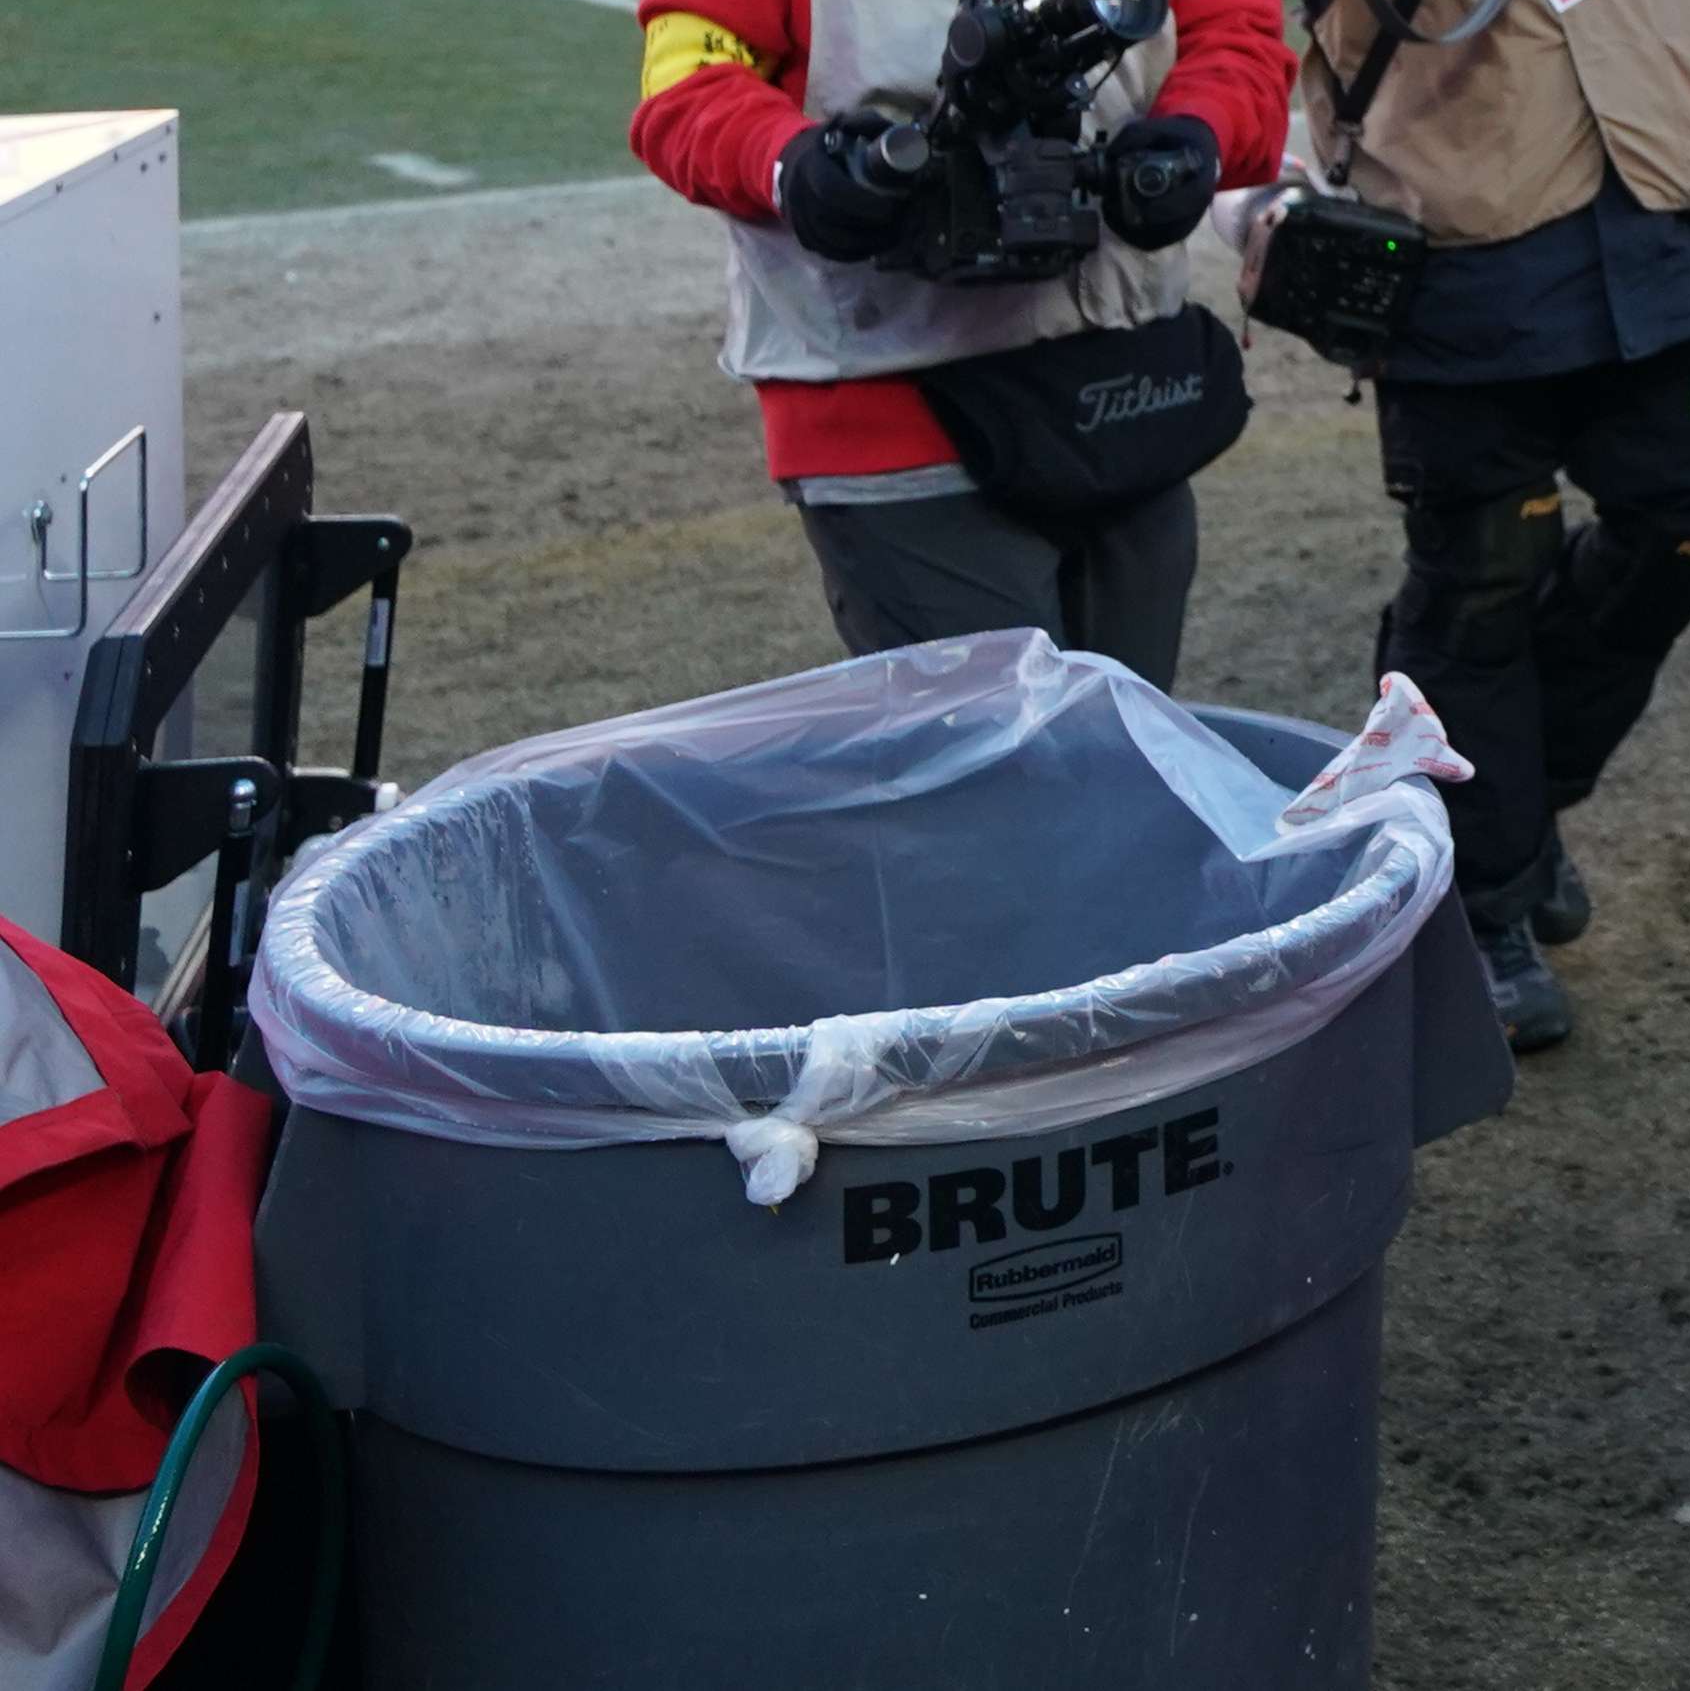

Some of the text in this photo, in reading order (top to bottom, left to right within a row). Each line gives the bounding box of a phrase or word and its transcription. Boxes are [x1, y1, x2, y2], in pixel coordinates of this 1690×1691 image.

[843, 1107, 1219, 1265] BRUTE
[976, 1242, 1116, 1293] Rubbermaid
[969, 1281, 1123, 1330] Commercial Products
